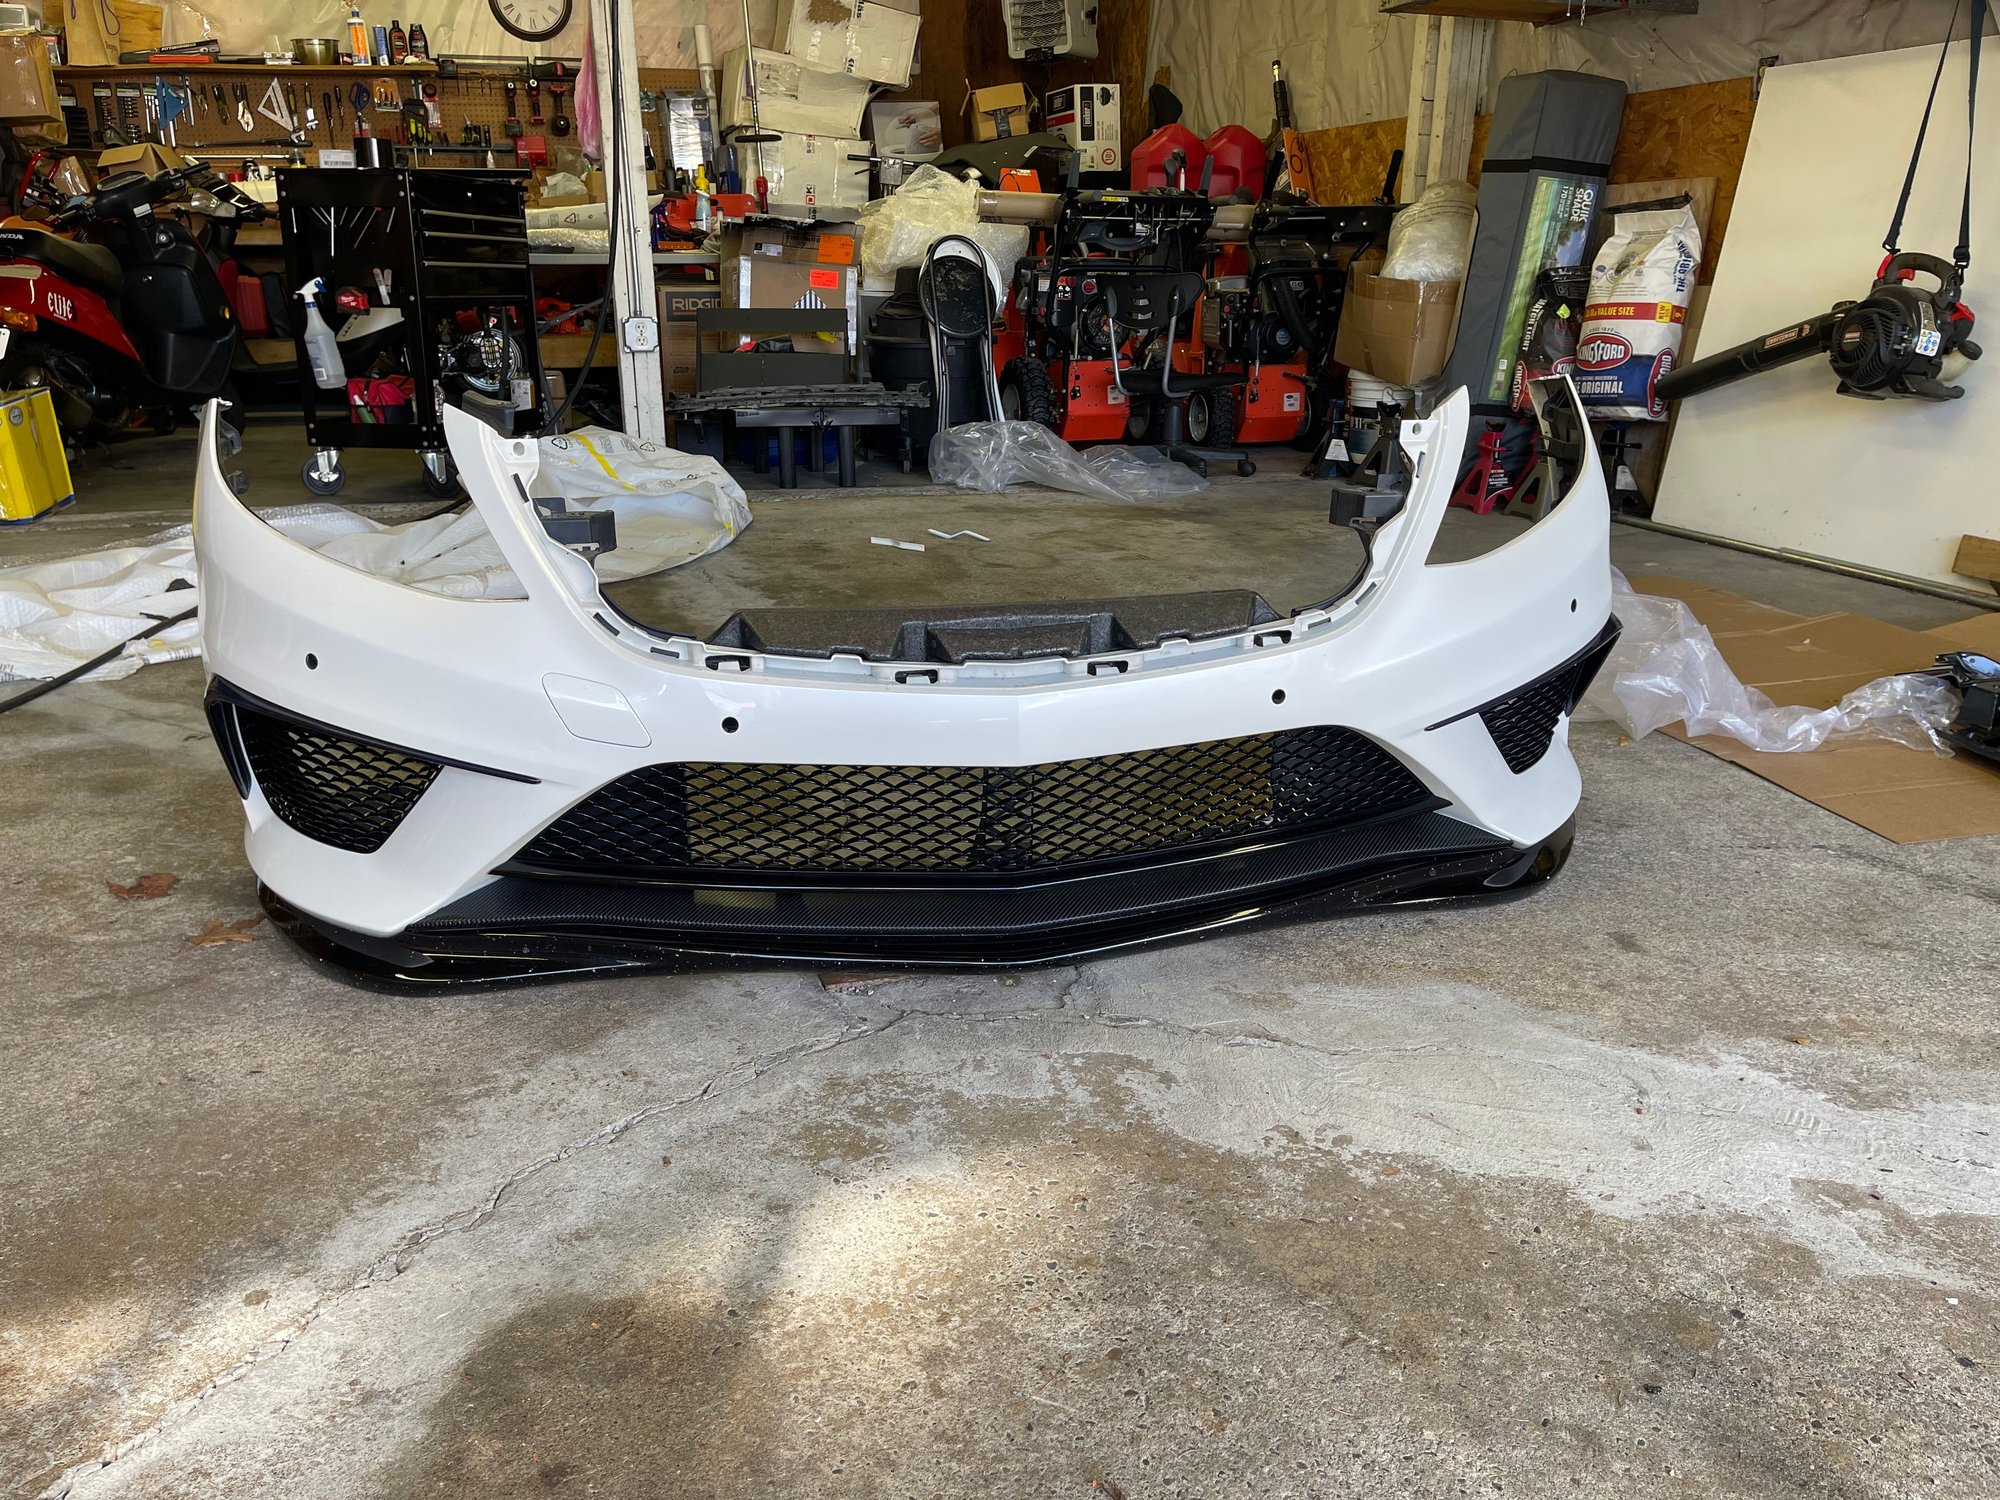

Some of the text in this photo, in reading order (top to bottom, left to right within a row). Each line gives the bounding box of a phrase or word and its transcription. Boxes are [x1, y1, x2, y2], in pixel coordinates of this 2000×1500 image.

[1561, 186, 1570, 199] 170
[1570, 188, 1585, 222] SHADE
[1578, 189, 1595, 223] QUIK
[1530, 298, 1548, 325] MATCH
[1597, 306, 1618, 316] VALUE
[1617, 306, 1636, 316] SIZE
[1522, 325, 1534, 352] LIGHT
[1581, 380, 1624, 394] ORIGINAL
